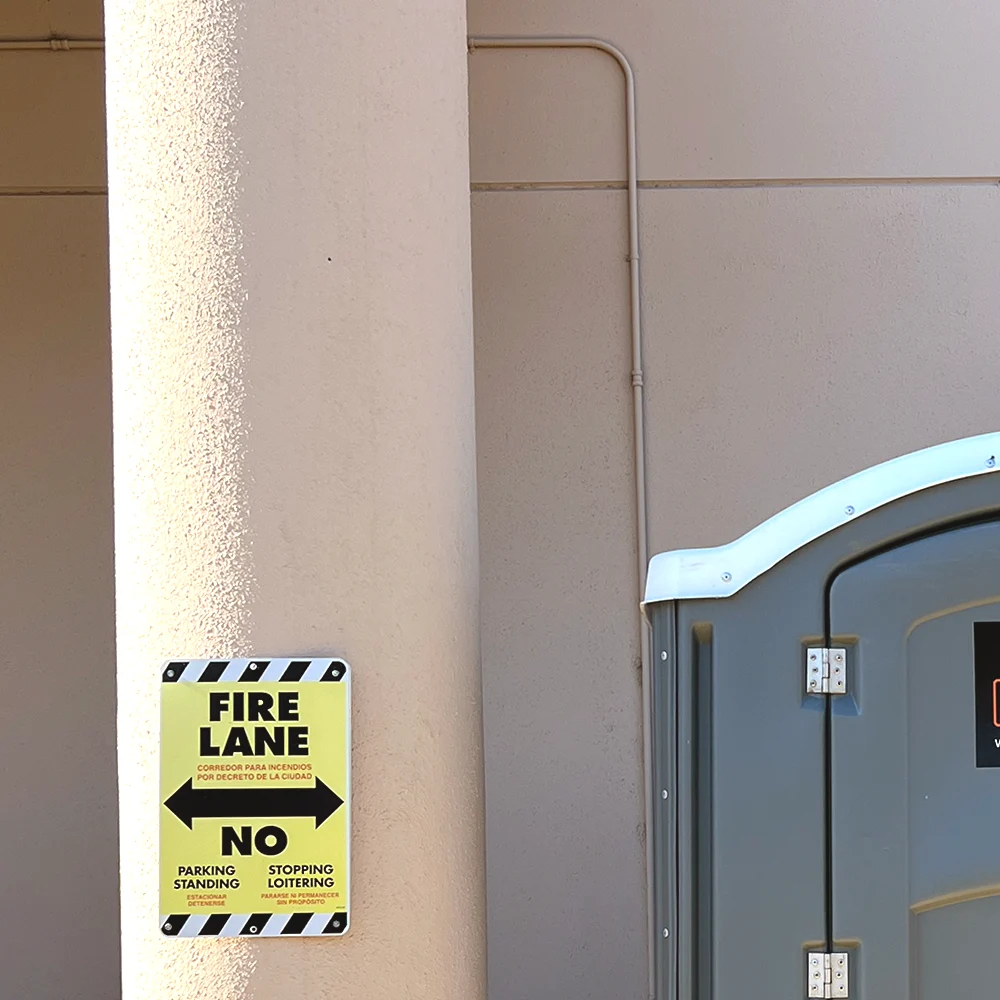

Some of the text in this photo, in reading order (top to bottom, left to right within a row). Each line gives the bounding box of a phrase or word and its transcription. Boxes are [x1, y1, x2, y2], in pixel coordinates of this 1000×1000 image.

[209, 692, 299, 722] FIRE
[199, 726, 309, 757] LANE
[197, 764, 243, 772] CORREDOR
[268, 763, 312, 771] INCENDIOS
[216, 773, 255, 781] DECRETO
[221, 825, 288, 856] NO
[178, 865, 236, 876] PARKING
[269, 864, 334, 875] STOPPING
[173, 879, 240, 890] STANDING
[268, 877, 334, 888] LOITERING
